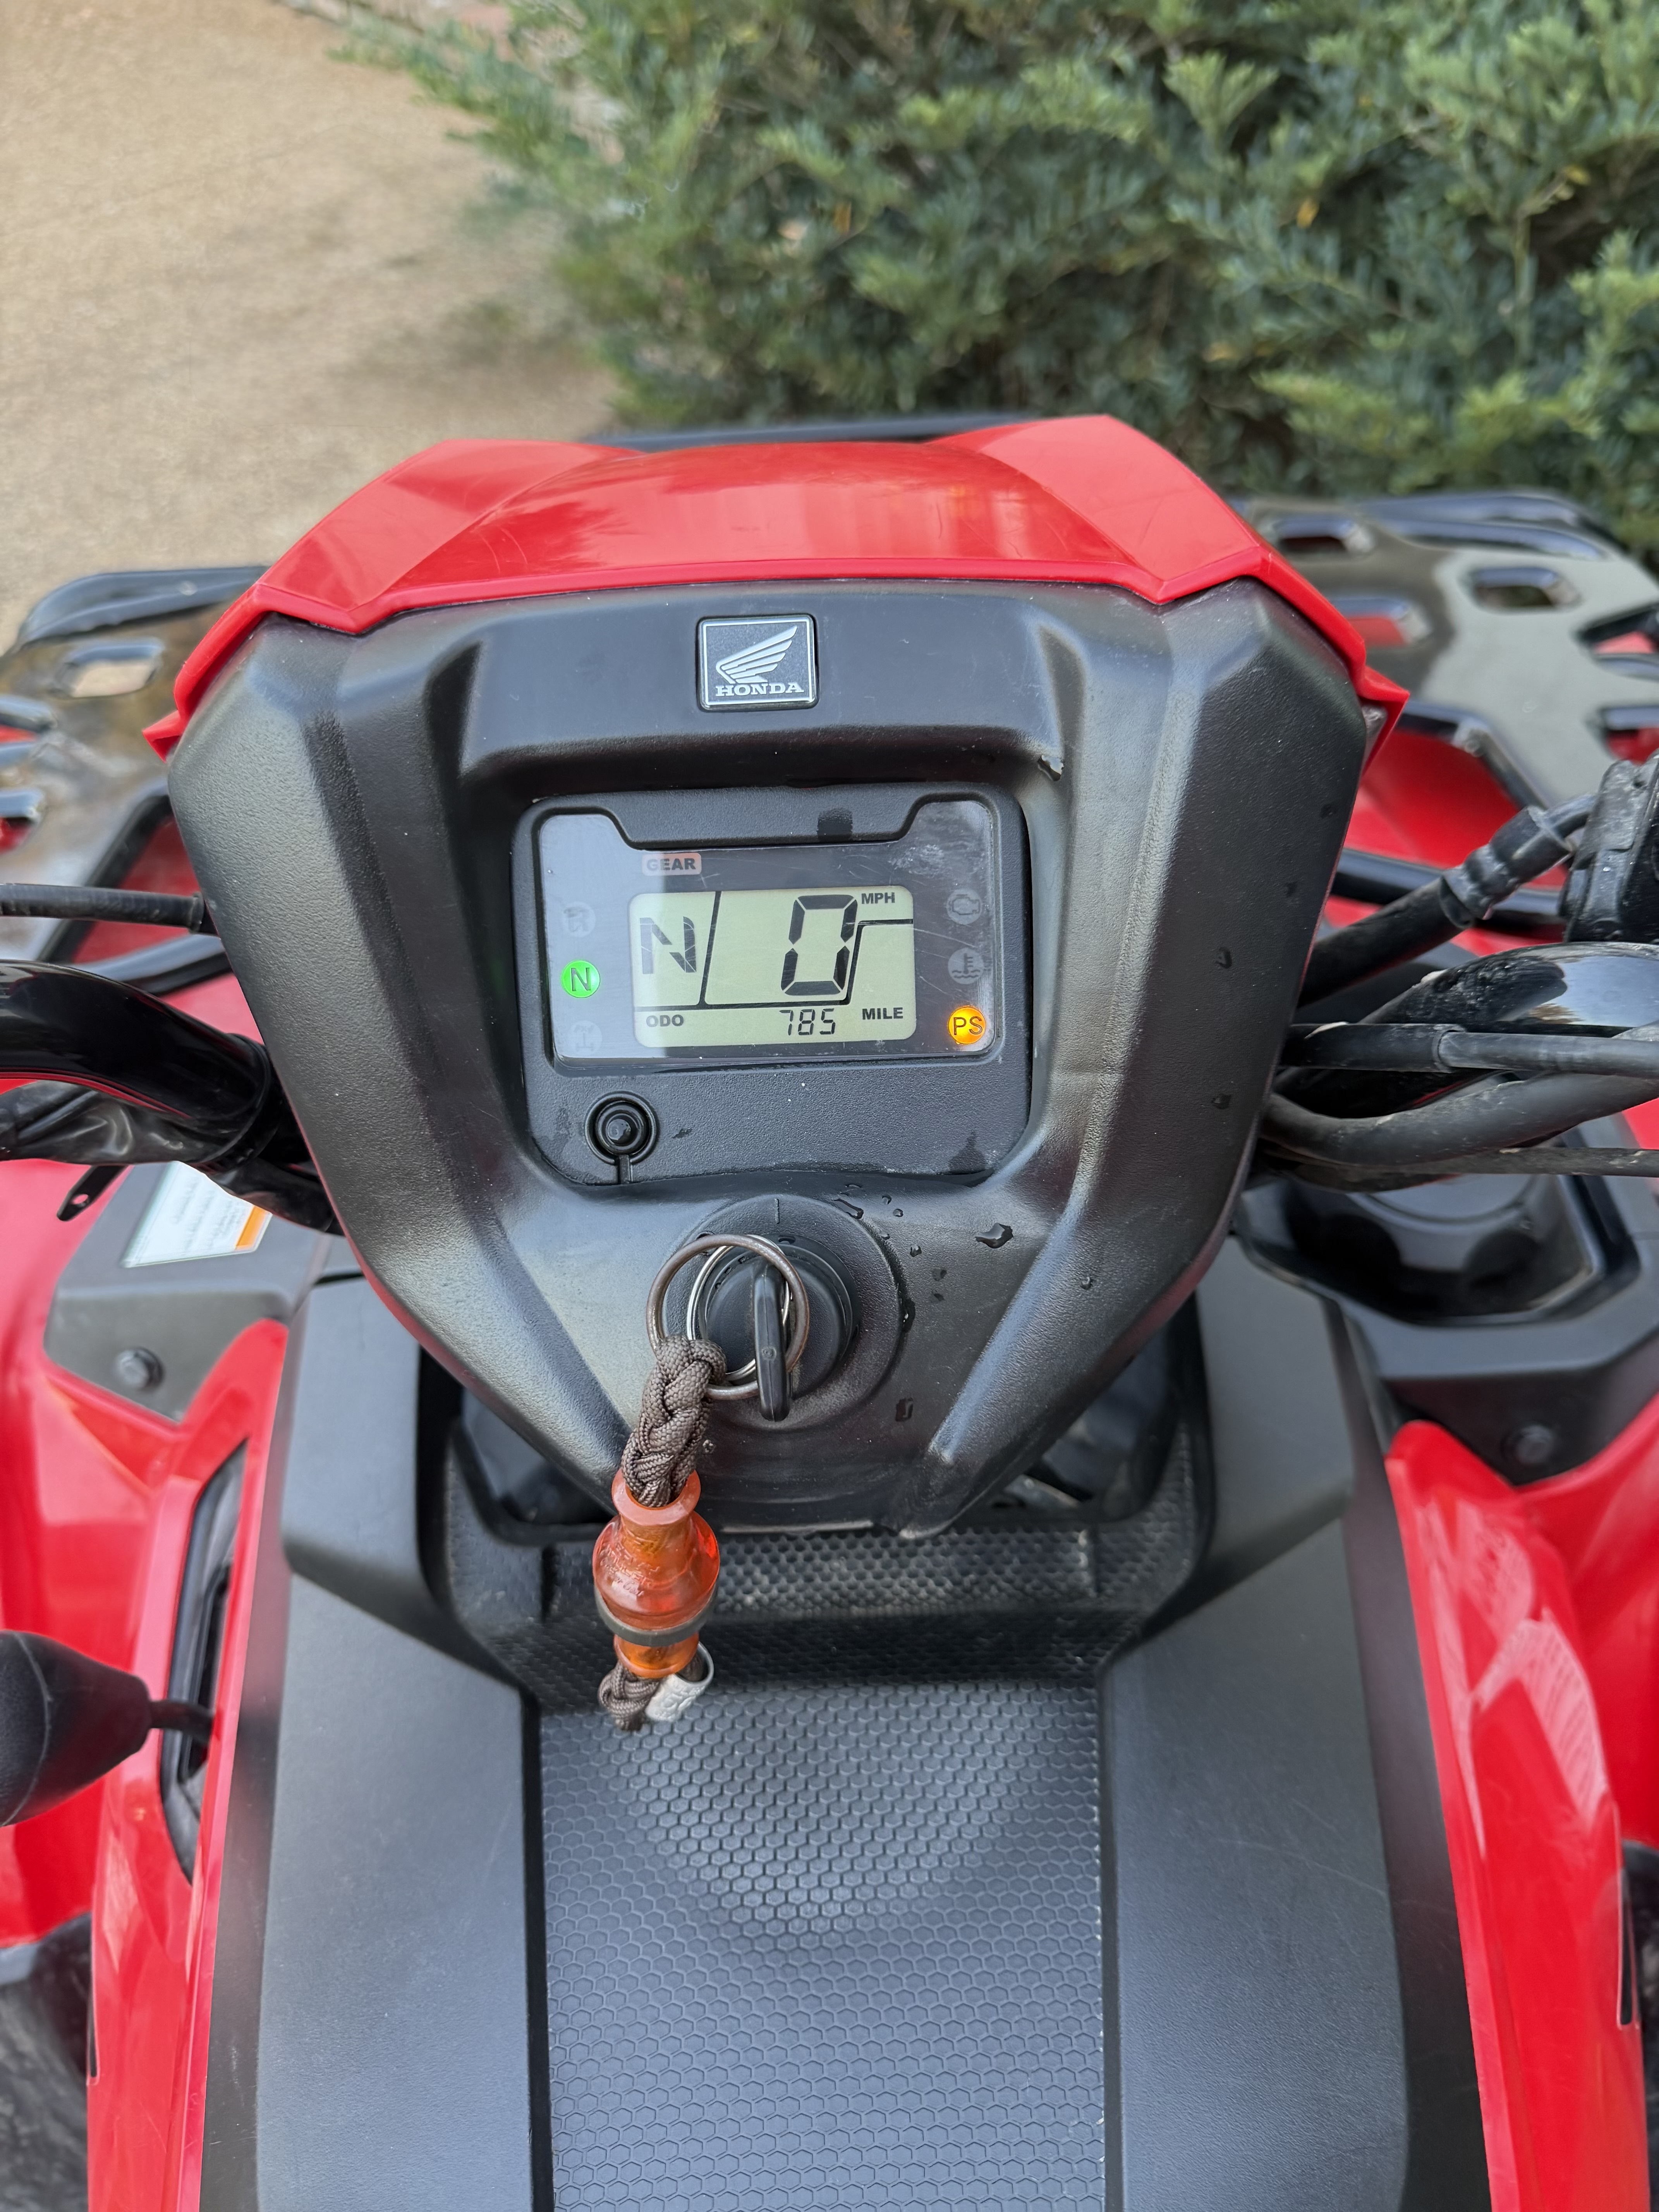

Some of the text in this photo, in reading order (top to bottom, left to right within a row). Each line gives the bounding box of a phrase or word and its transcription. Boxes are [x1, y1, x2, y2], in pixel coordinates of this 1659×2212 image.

[715, 682, 804, 696] HONDA
[646, 858, 696, 871] GEAR
[639, 916, 696, 974] N
[781, 892, 895, 996] 0 MPH
[571, 967, 591, 991] N
[646, 1007, 903, 1036] ODO 785 MILE
[953, 1016, 983, 1035] PS
